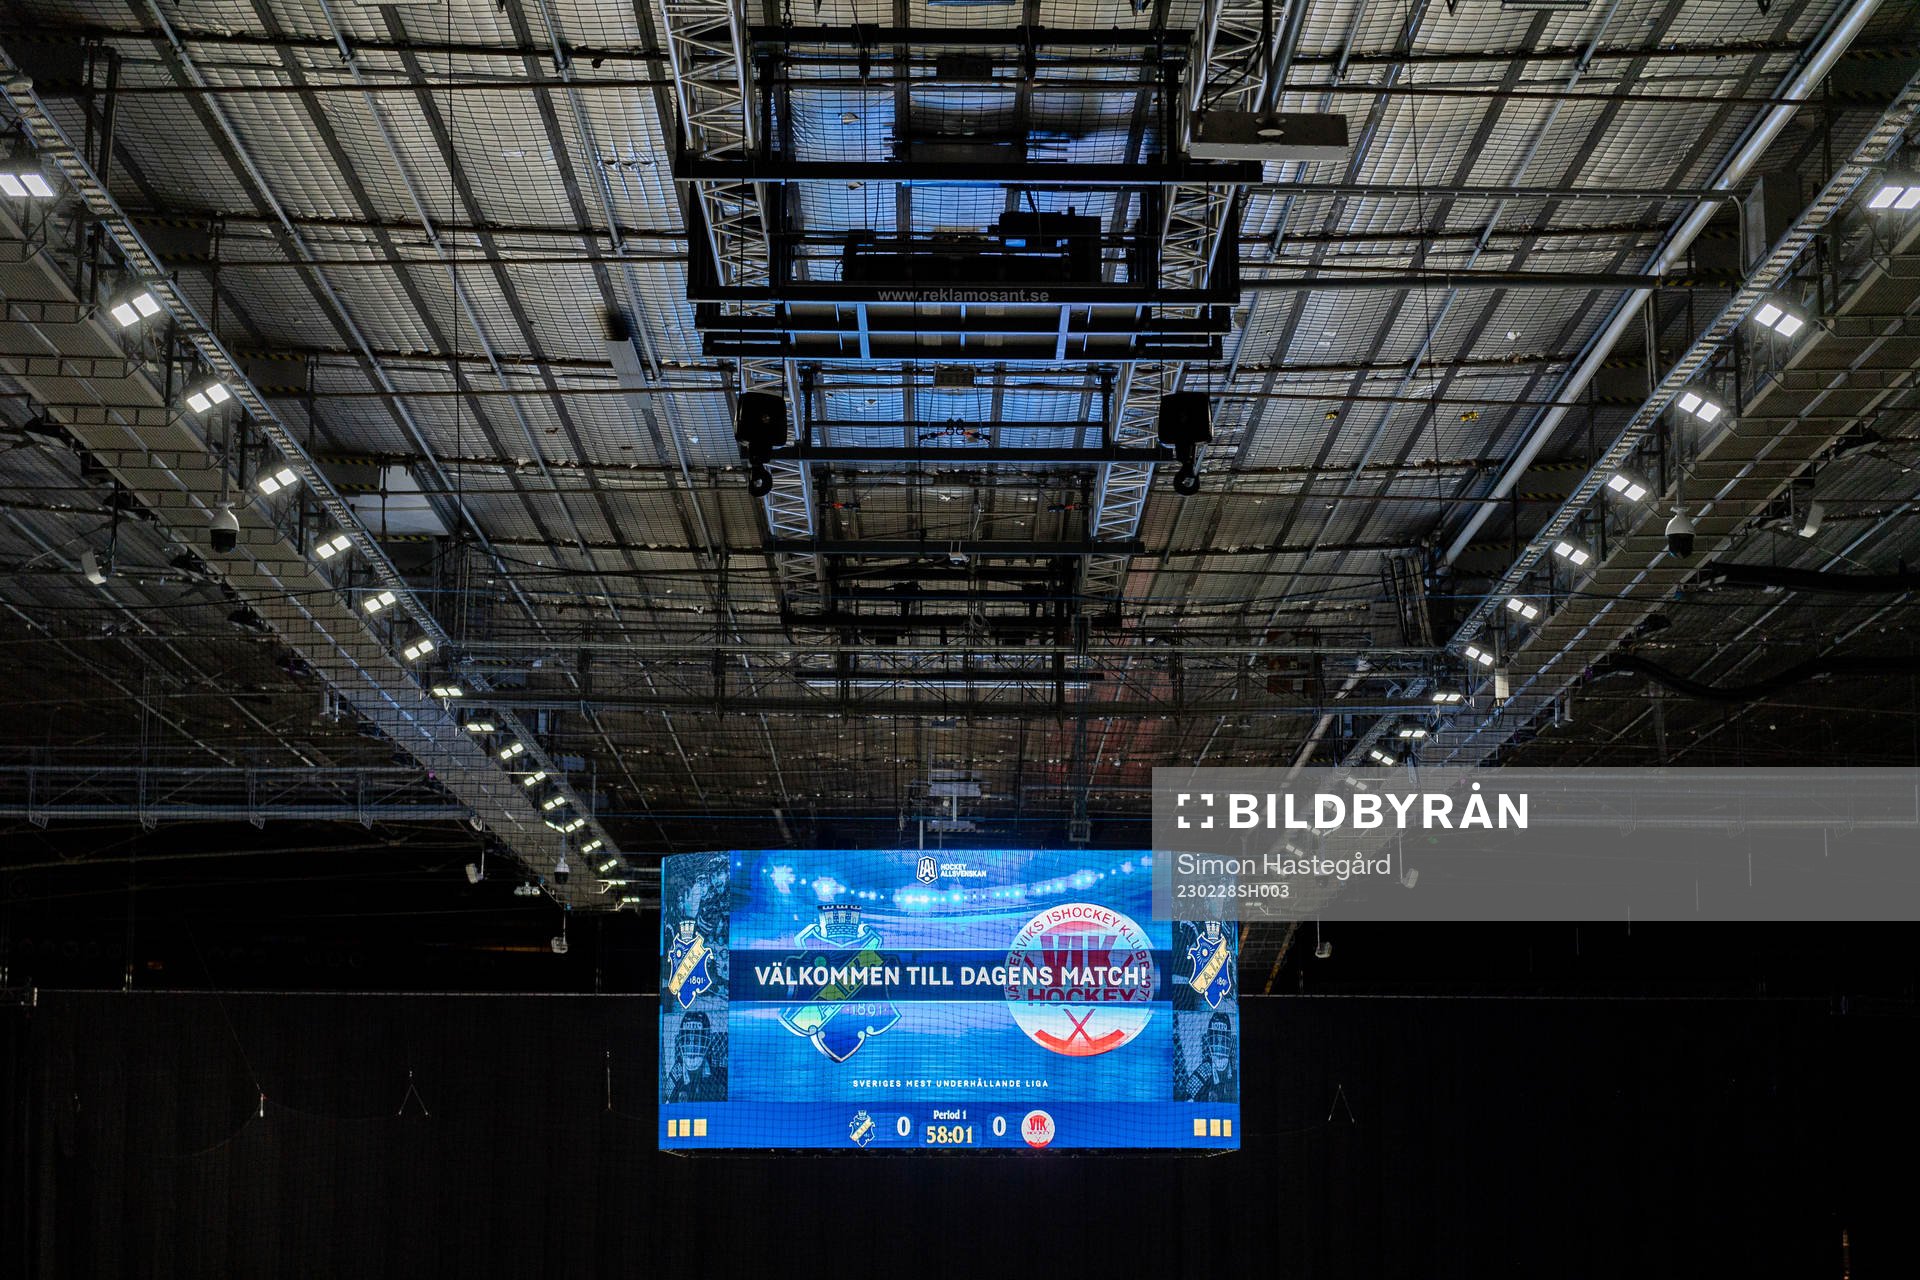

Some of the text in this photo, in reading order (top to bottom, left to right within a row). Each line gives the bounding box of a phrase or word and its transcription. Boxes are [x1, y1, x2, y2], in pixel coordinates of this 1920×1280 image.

[877, 288, 1049, 302] www.reklamosant.se
[1040, 935, 1119, 988] VIK
[754, 962, 1148, 986] VÄLKOMMEN TILL DAGENS MATCH!
[852, 1077, 1049, 1088] SVERIGES MEST UNDERHÅLLANDE LIGA
[933, 1110, 967, 1120] Period 1
[896, 1116, 911, 1137] 0
[926, 1125, 973, 1145] 58:01
[992, 1116, 1007, 1137] 0
